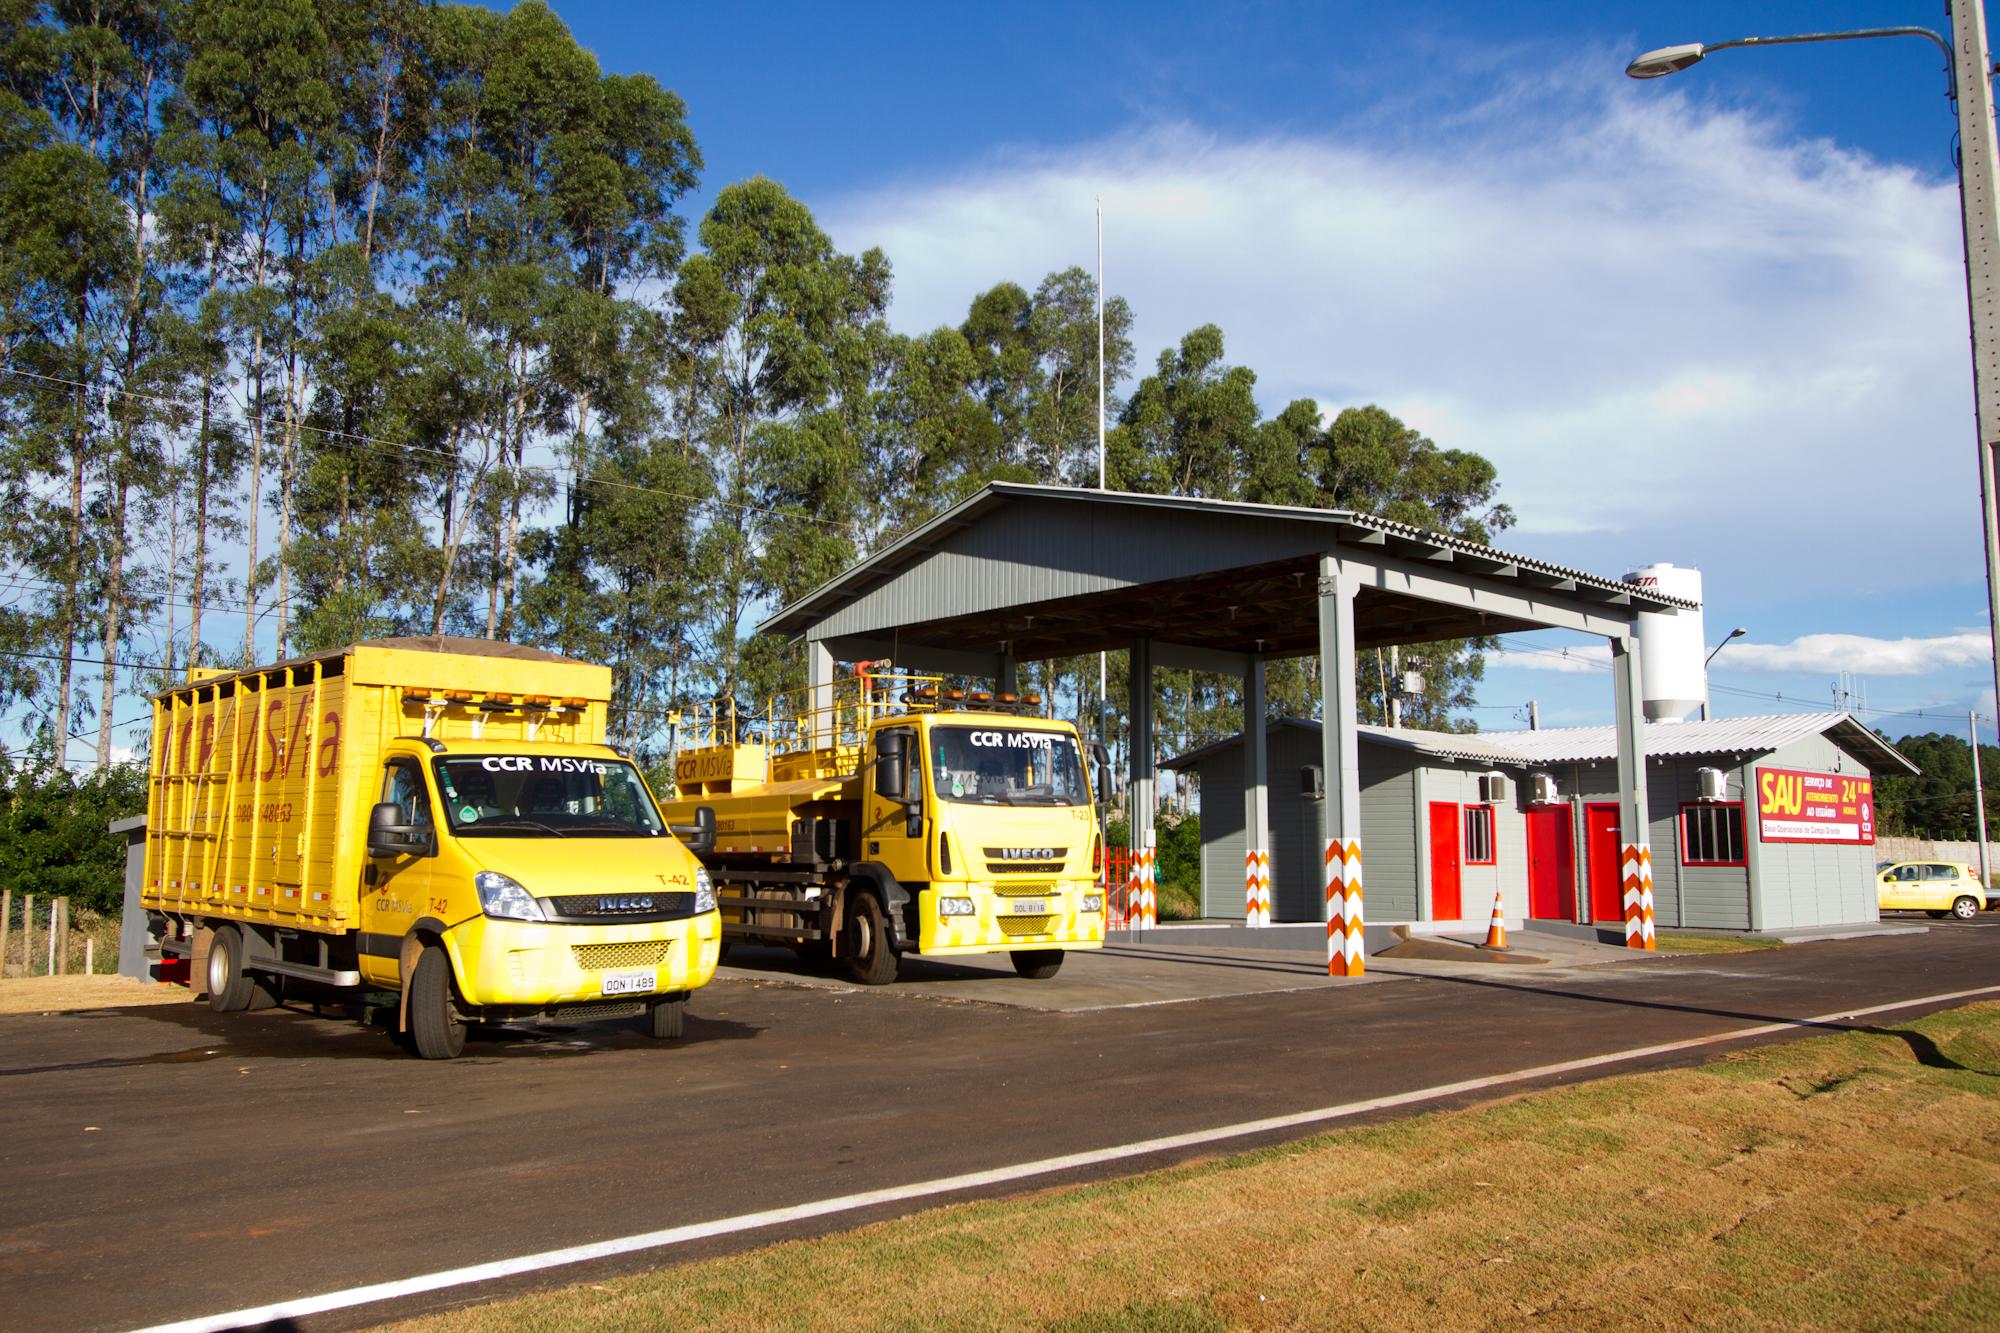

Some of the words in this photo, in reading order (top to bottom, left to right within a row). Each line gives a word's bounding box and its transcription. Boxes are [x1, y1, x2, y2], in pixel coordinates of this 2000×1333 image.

[970, 731, 1003, 747] CCR
[1007, 733, 1052, 749] MSVia
[482, 757, 534, 772] CCR
[540, 757, 607, 775] MSVia
[676, 759, 697, 780] CCR
[700, 755, 732, 777] MSVia
[1761, 772, 1802, 815] SAU
[1806, 792, 1838, 803] ATENDIMENTO
[1841, 780, 1856, 803] 24
[1071, 809, 1089, 821] T-23
[1807, 807, 1815, 816] AO
[1843, 807, 1856, 815] HORAS
[1764, 824, 1776, 833] Base
[1777, 825, 1803, 834] Operacional
[1811, 826, 1825, 836] Campo
[1002, 848, 1055, 860] IVECO
[656, 874, 690, 885] T-42
[376, 898, 390, 912] CCR
[430, 897, 448, 914] T-42
[598, 896, 654, 910] IVECO
